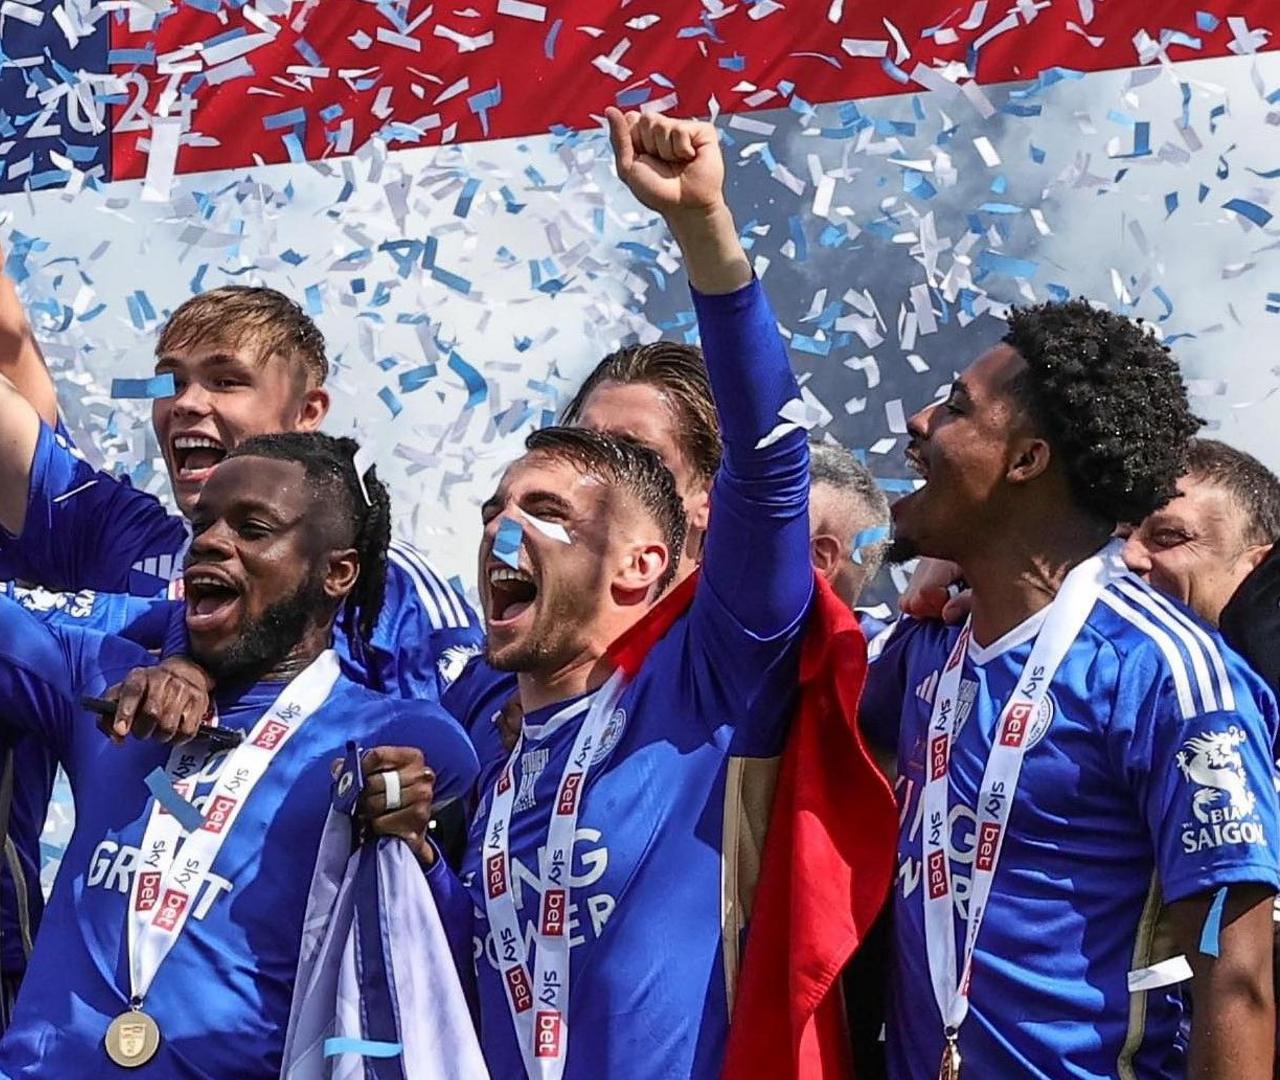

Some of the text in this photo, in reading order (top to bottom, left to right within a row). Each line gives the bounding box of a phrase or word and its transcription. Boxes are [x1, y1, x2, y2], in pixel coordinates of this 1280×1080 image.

[255, 702, 302, 749] sky bet
[933, 699, 951, 779] sky bet
[1005, 666, 1044, 742] sky bet
[205, 767, 250, 831] sky bet
[559, 735, 592, 812] sky bet
[489, 820, 506, 895] sky bet
[929, 811, 945, 891] sky bet
[978, 781, 1005, 867] sky bet
[1181, 822, 1268, 853] SAIGON
[88, 841, 233, 920] GRT
[139, 839, 167, 909] sky bet
[155, 857, 201, 929] sky bet
[546, 849, 564, 932] sky bet
[500, 927, 531, 1009] sky bet
[538, 969, 561, 1054] sky bet
